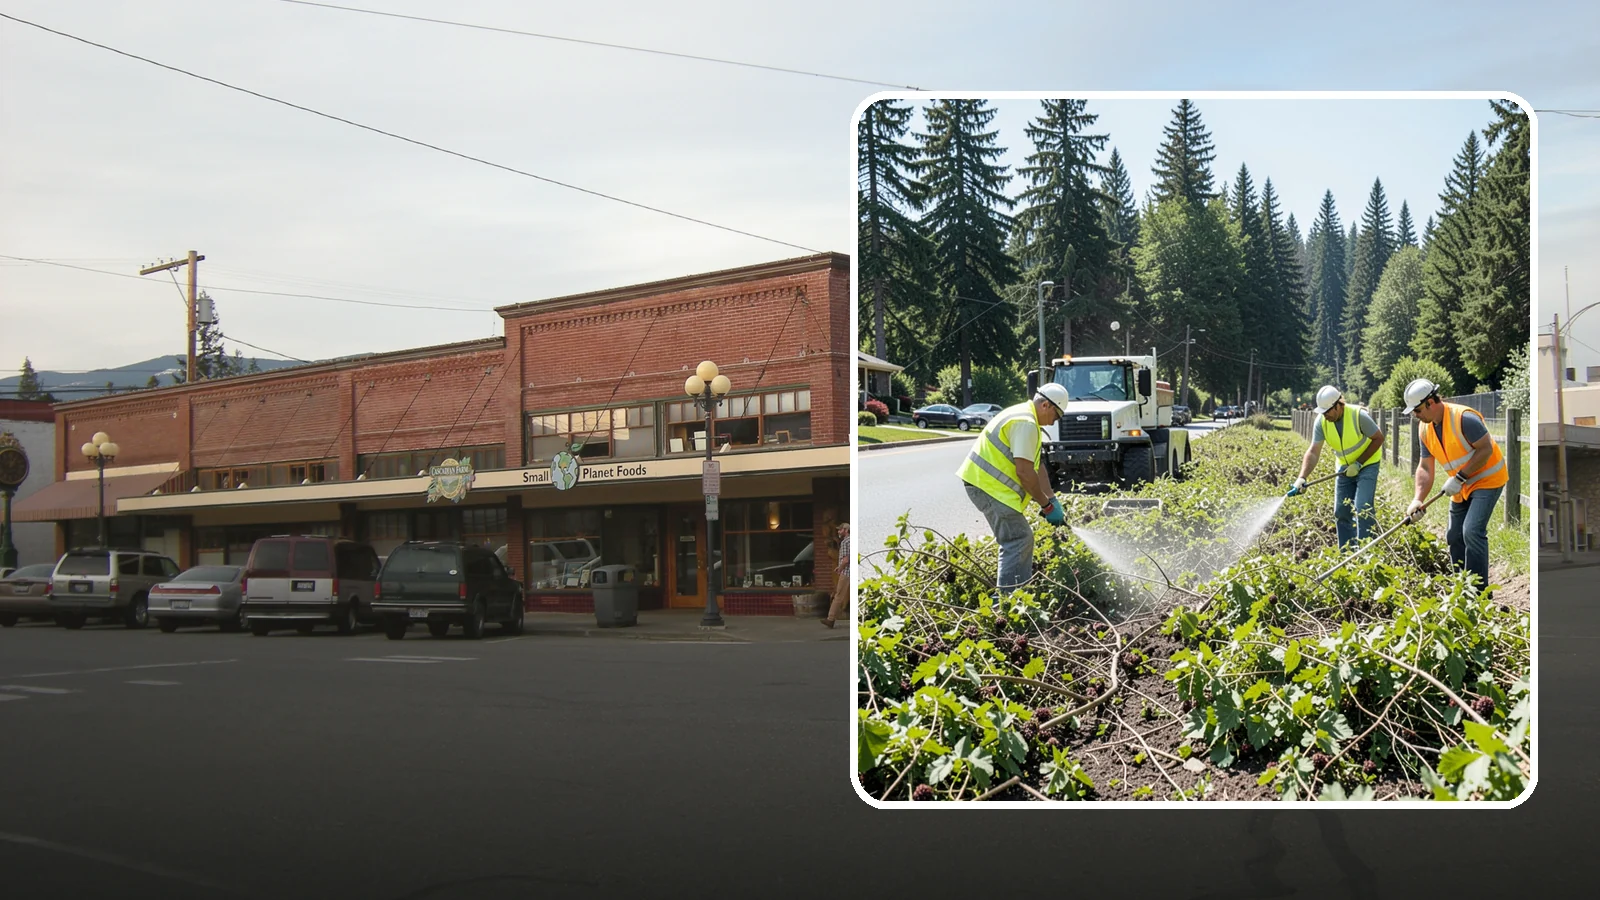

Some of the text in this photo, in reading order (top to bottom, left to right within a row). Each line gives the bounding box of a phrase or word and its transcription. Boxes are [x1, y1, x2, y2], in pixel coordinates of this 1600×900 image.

[523, 464, 647, 483] Small Planet Foods
